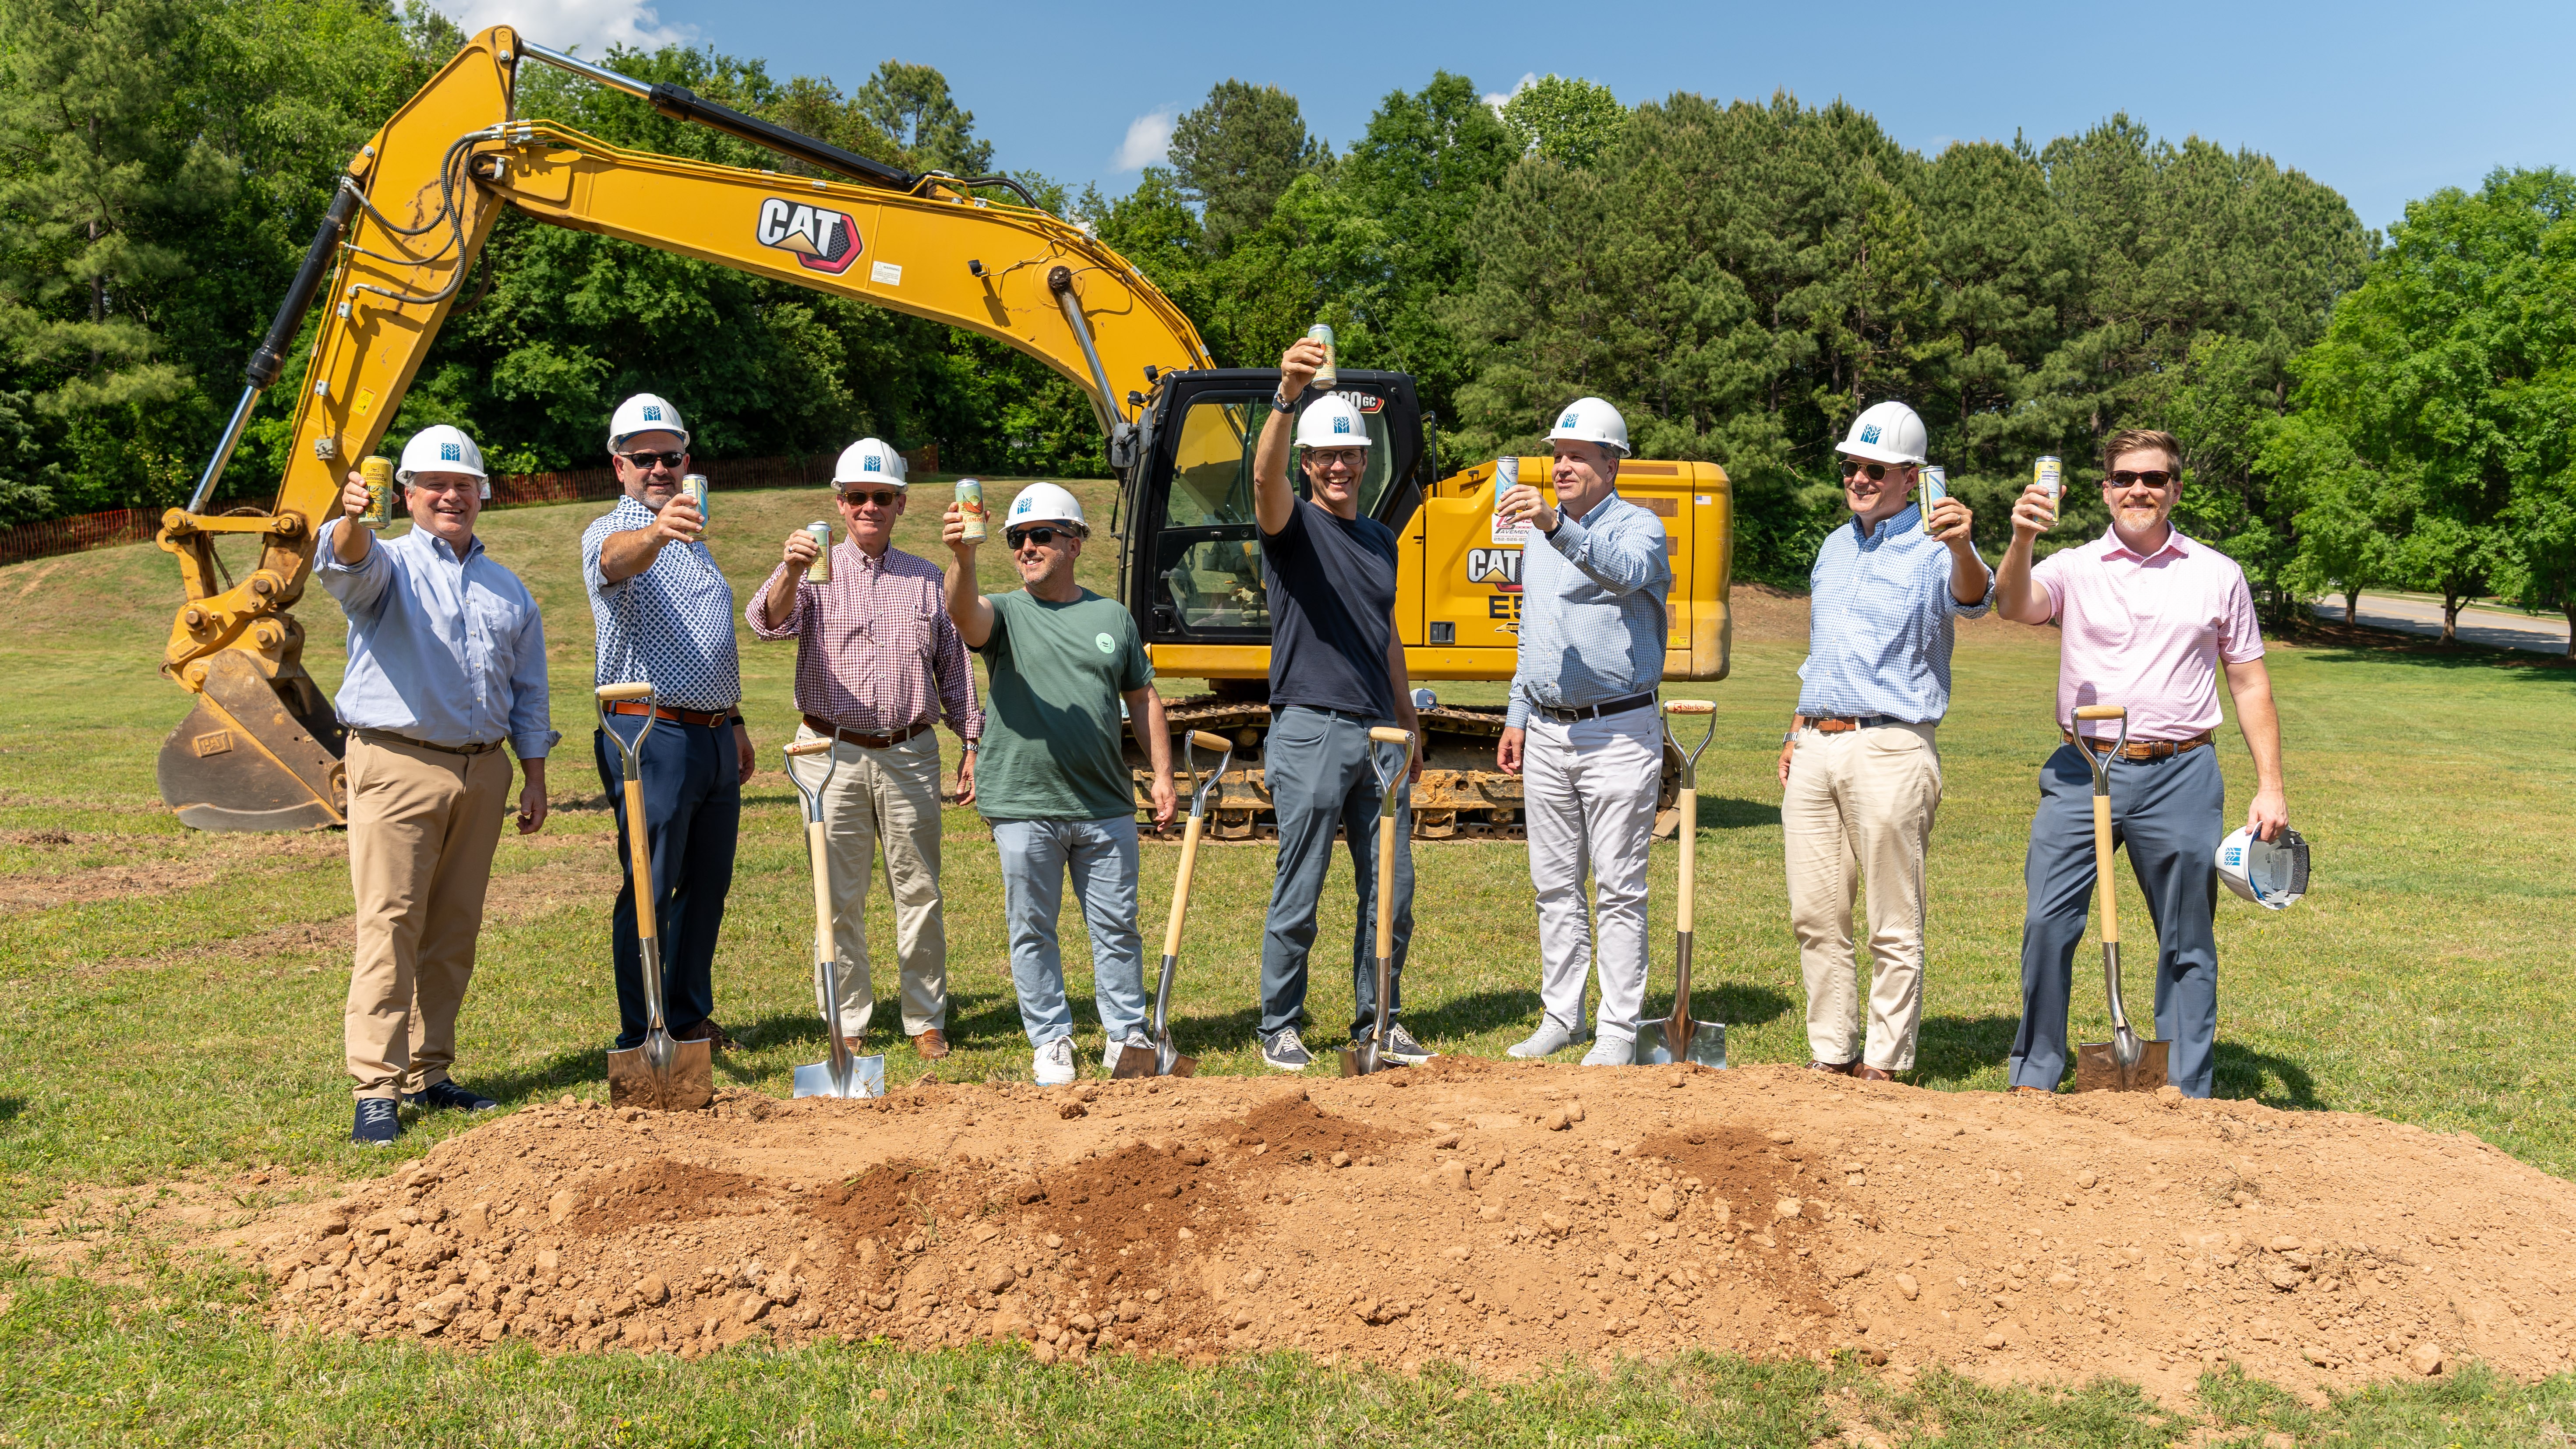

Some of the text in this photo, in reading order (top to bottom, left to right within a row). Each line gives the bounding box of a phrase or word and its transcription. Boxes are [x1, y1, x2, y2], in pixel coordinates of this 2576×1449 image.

[758, 198, 841, 257] CAT
[1362, 396, 1376, 407] GC
[1468, 549, 1520, 582] CAT
[200, 734, 226, 754] CAT
